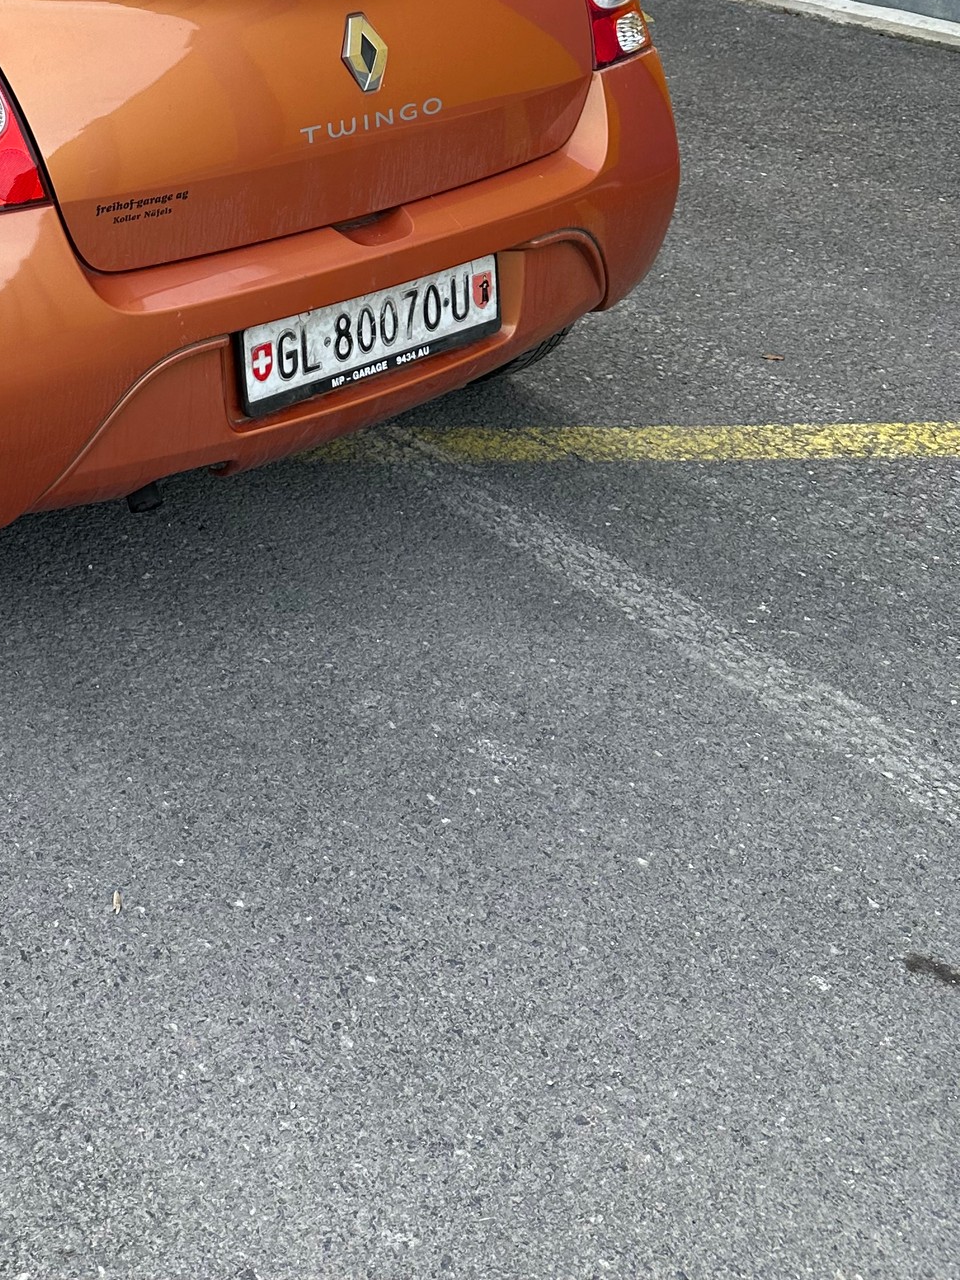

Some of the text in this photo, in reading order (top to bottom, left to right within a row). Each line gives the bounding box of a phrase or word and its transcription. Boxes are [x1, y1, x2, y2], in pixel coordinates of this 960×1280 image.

[300, 97, 442, 144] TWINGO
[176, 190, 189, 200] ag
[113, 207, 173, 224] Koller Näfels
[331, 375, 345, 388] MP
[352, 360, 388, 380] GARAGE
[395, 351, 417, 365] 9434
[417, 345, 430, 357] AU
